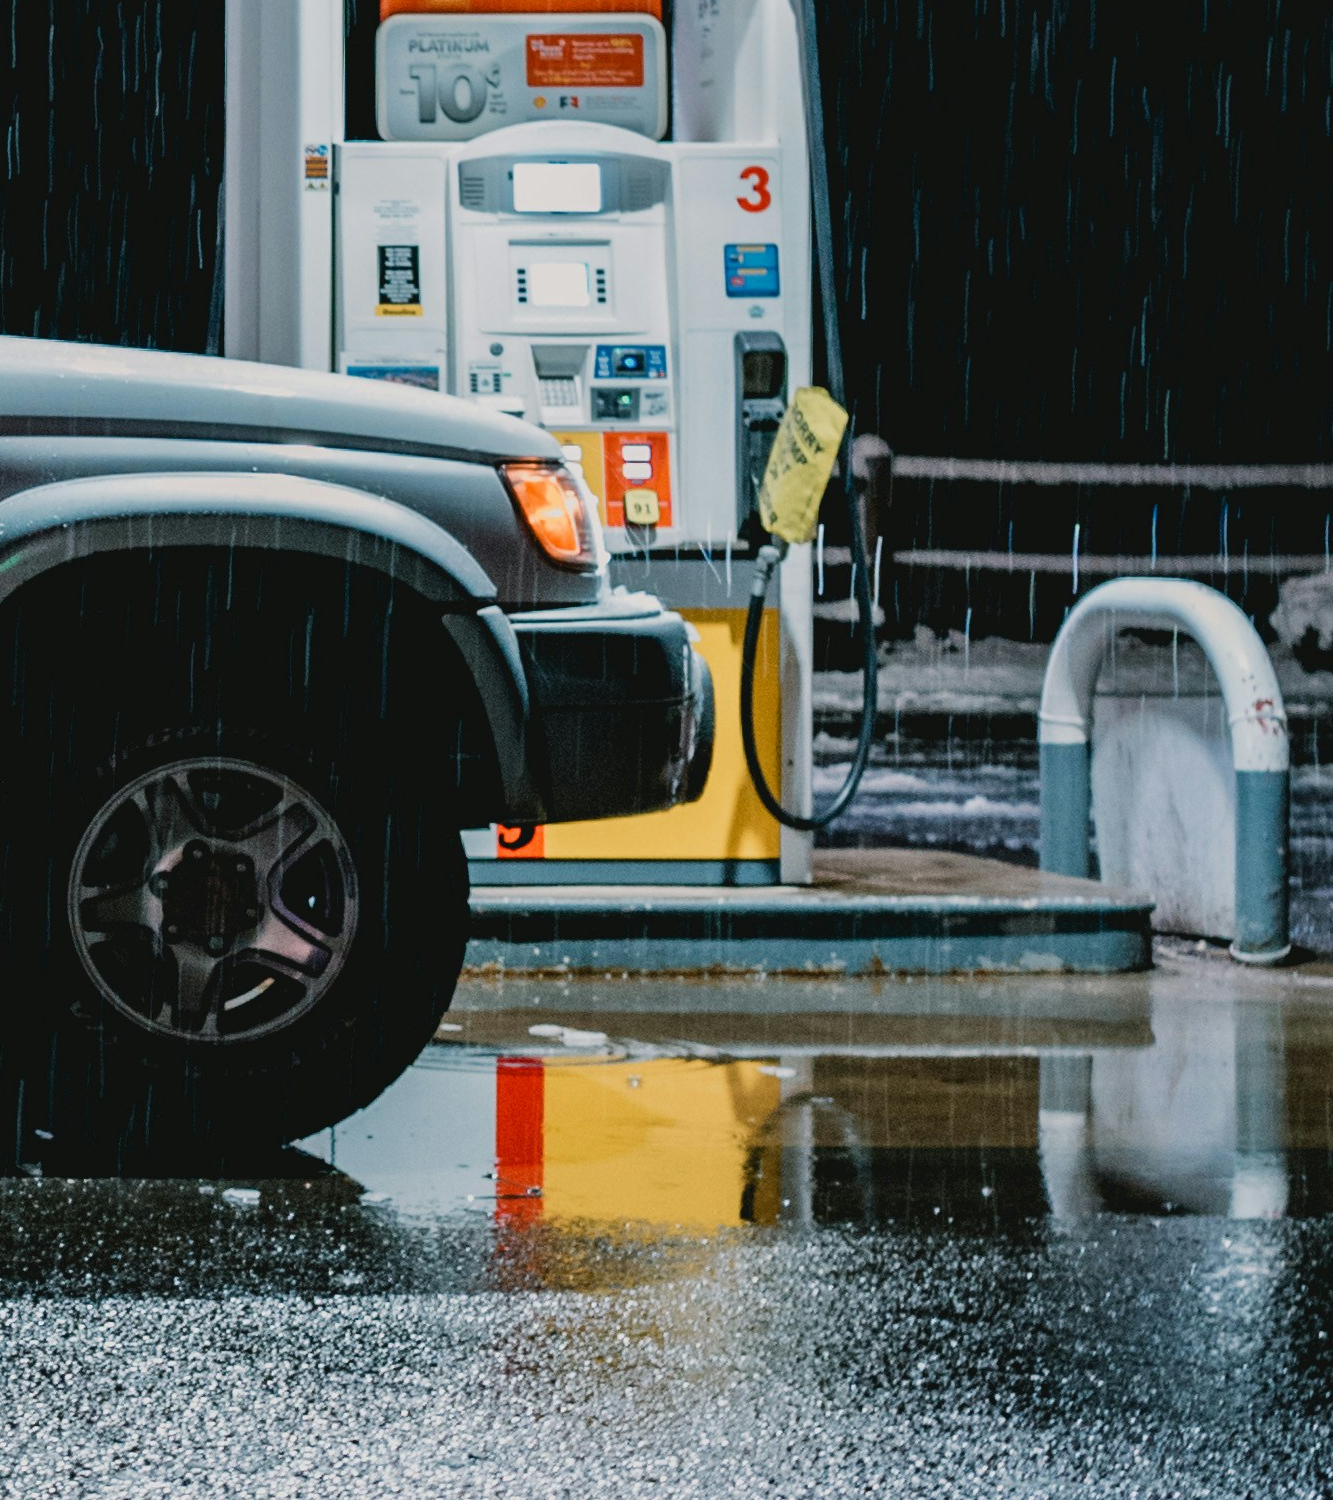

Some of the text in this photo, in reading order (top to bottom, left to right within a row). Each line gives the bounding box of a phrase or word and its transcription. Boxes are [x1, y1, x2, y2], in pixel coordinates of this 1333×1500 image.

[408, 39, 490, 53] PLATINUM
[735, 165, 772, 214] 3
[634, 503, 651, 514] 91
